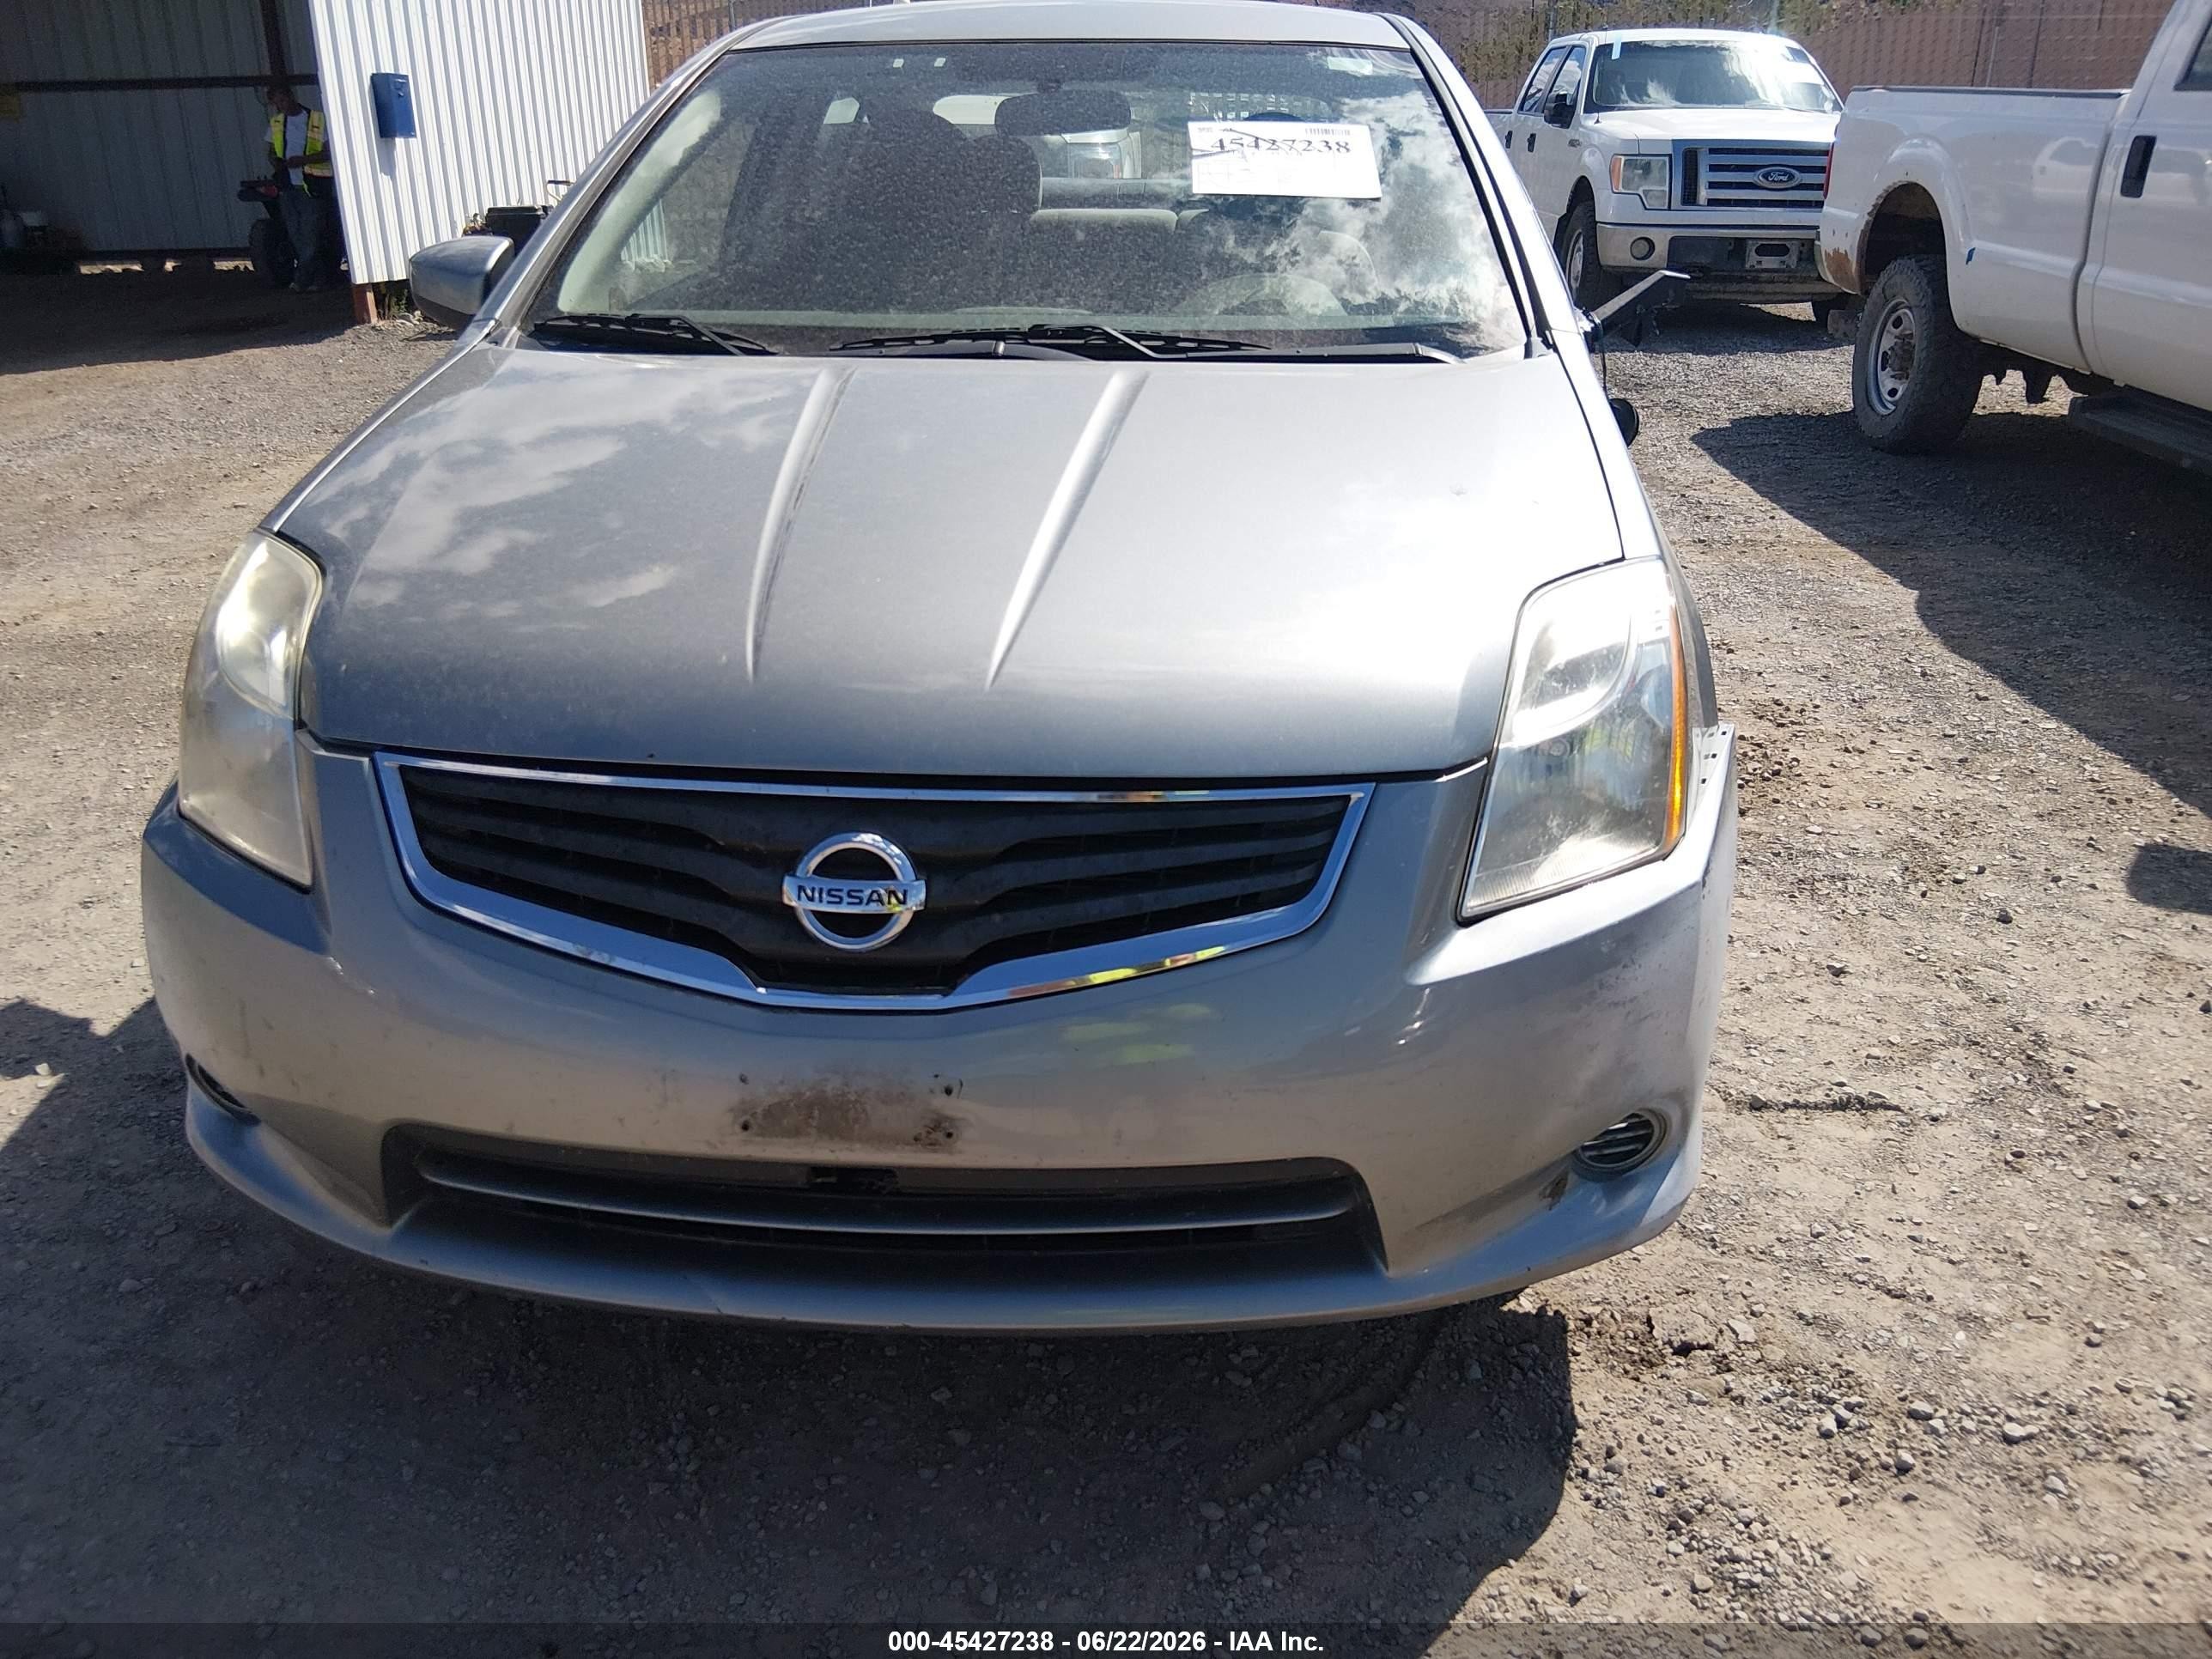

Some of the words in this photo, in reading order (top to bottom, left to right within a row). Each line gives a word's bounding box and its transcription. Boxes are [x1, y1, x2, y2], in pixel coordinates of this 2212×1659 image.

[1211, 137, 1352, 154] 45427238
[1768, 171, 1790, 182] Ford
[797, 884, 908, 906] NISSAN
